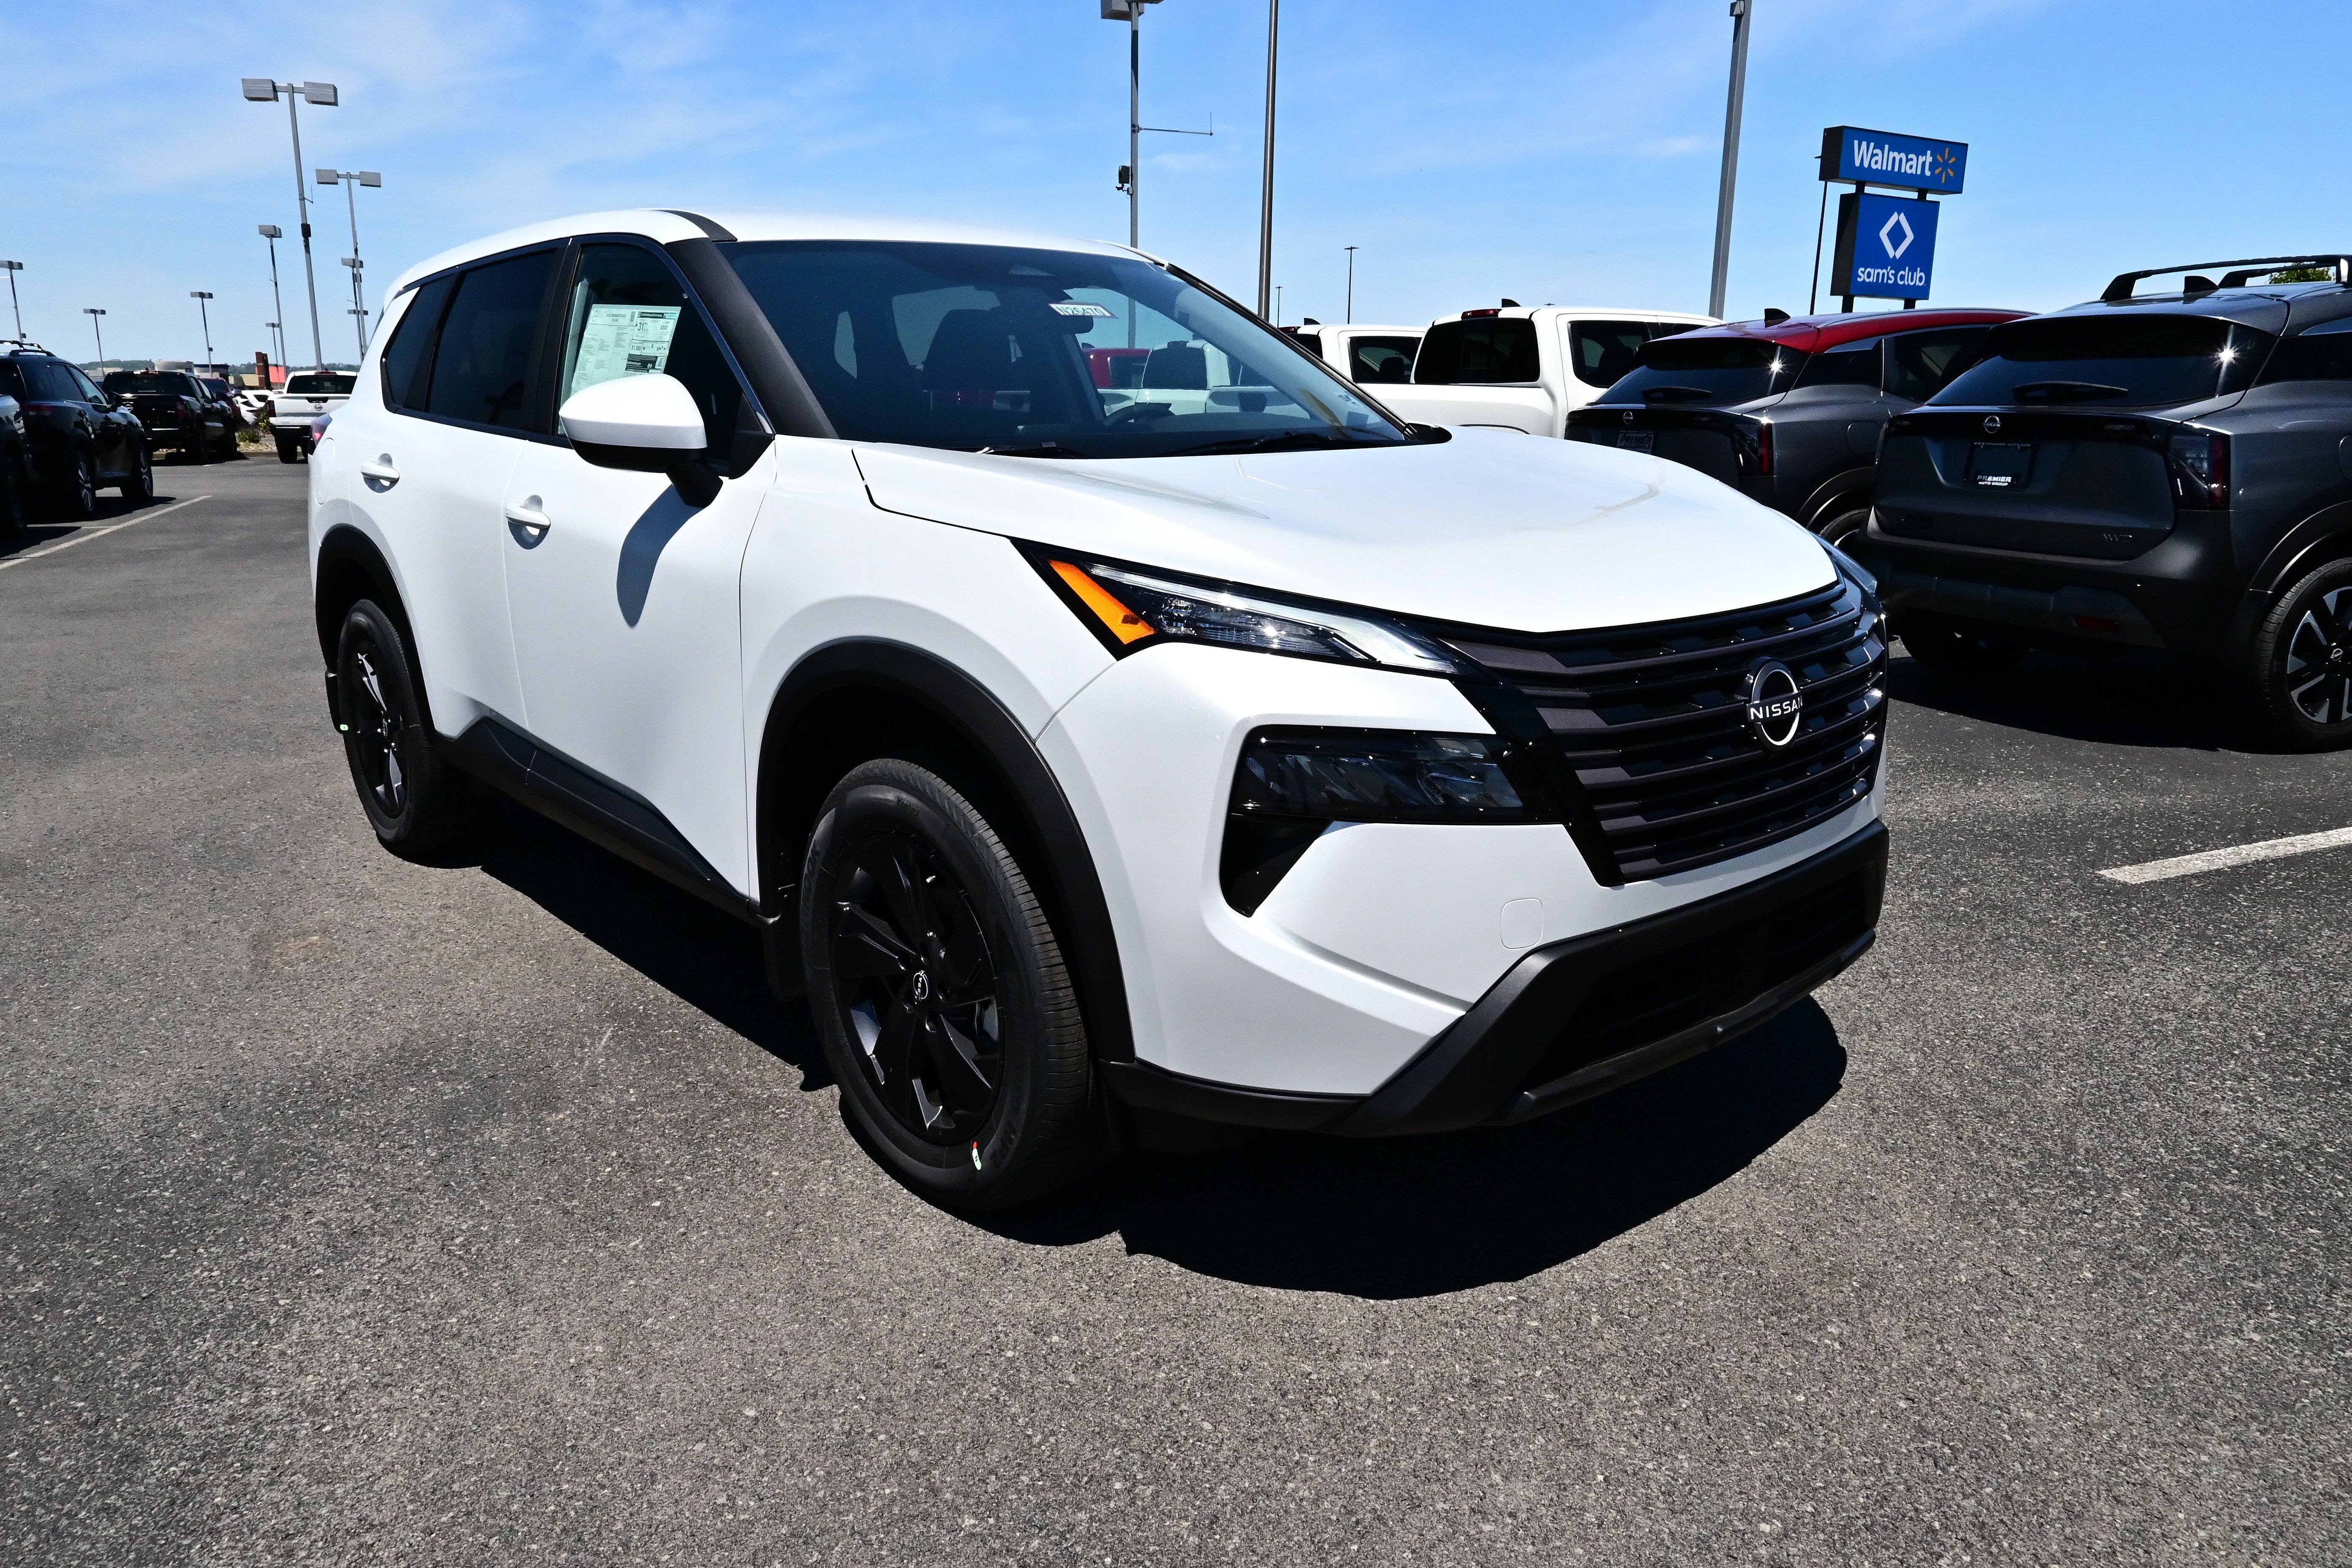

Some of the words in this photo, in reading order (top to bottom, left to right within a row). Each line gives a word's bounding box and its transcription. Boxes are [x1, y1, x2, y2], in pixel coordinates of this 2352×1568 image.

[1854, 140, 1933, 176] Walmart
[1857, 266, 1895, 284] sam's
[1897, 267, 1925, 286] club
[1055, 306, 1105, 315] N26470
[637, 322, 644, 331] 31
[1620, 436, 1652, 445] PREMIER
[1750, 695, 1803, 720] NISSAN
